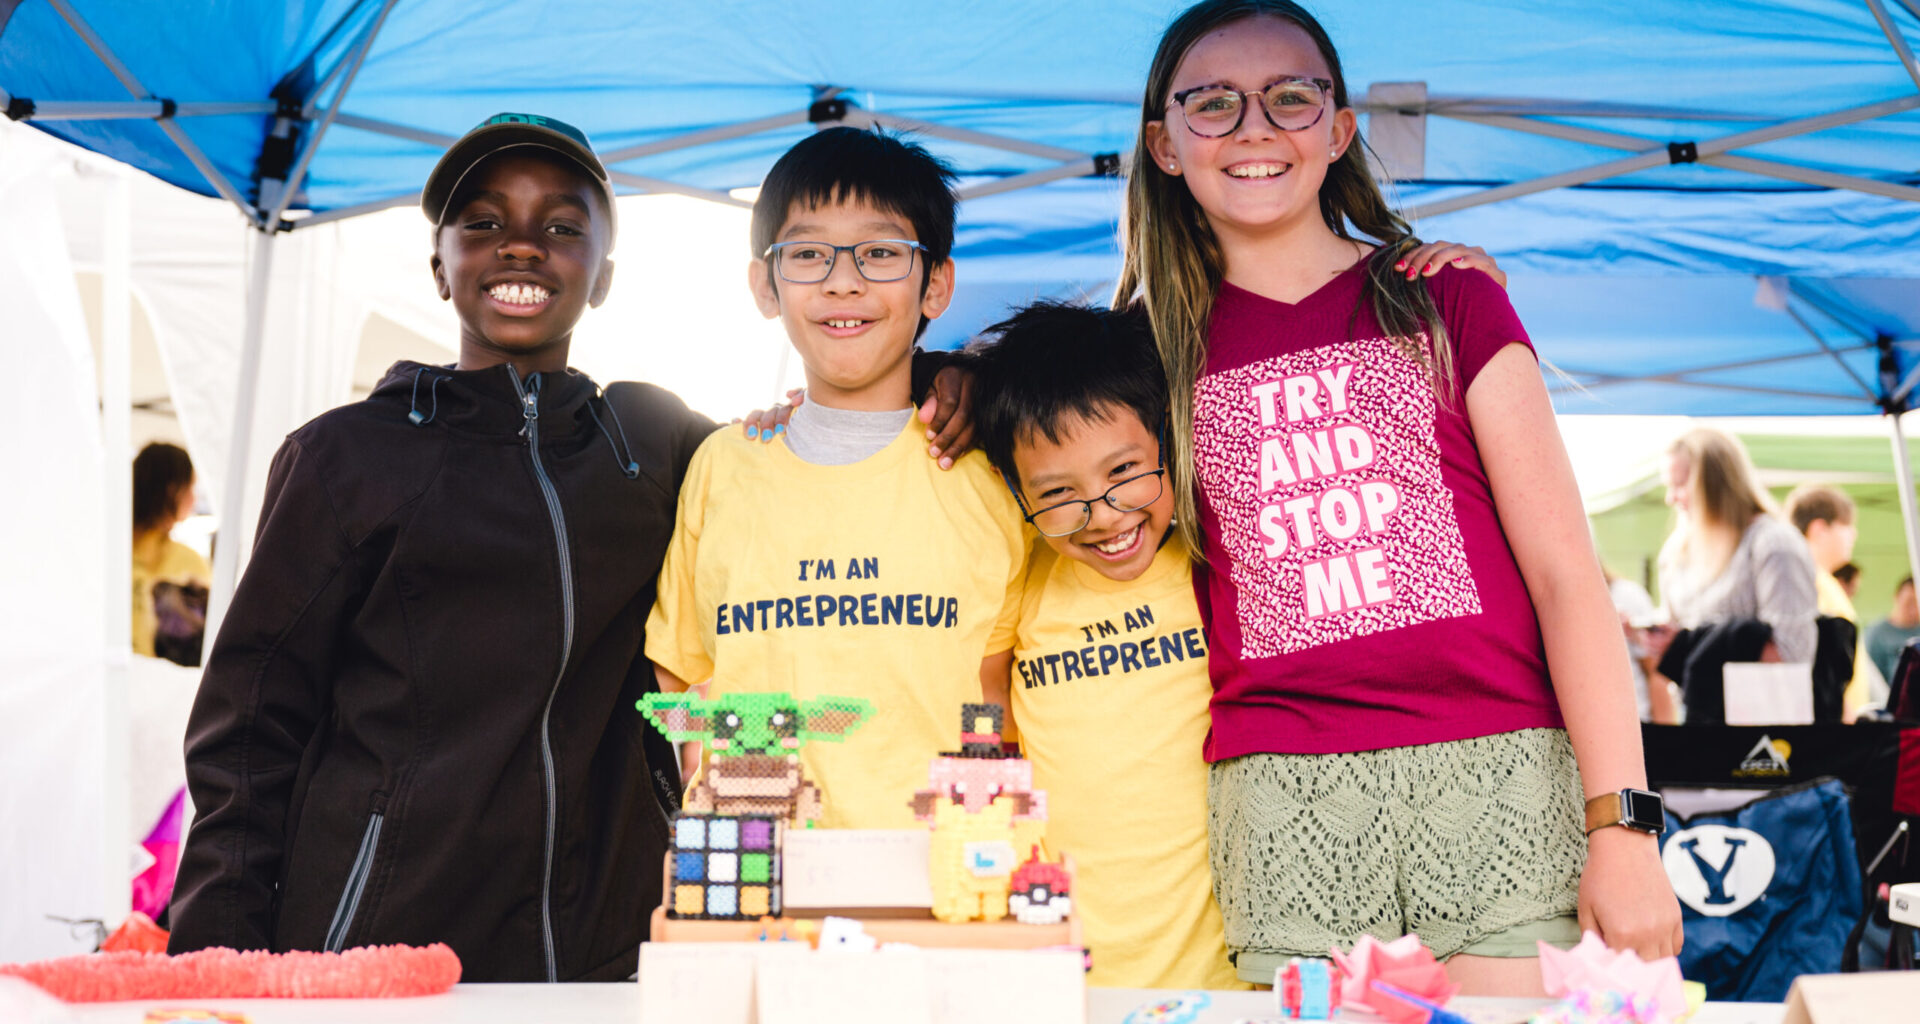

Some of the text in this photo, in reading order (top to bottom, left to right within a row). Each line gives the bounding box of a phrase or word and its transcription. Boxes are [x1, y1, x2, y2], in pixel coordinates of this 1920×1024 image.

[1250, 362, 1357, 429] TRY
[1257, 423, 1377, 496] AND
[1257, 478, 1401, 561] STOP
[798, 557, 879, 581] I'M AN
[1301, 546, 1397, 620] ME
[716, 593, 958, 635] ENTREPRENEUR
[1080, 604, 1155, 643] I'M AN
[1017, 627, 1209, 689] ENTREPRENE
[1679, 836, 1747, 904] Y
